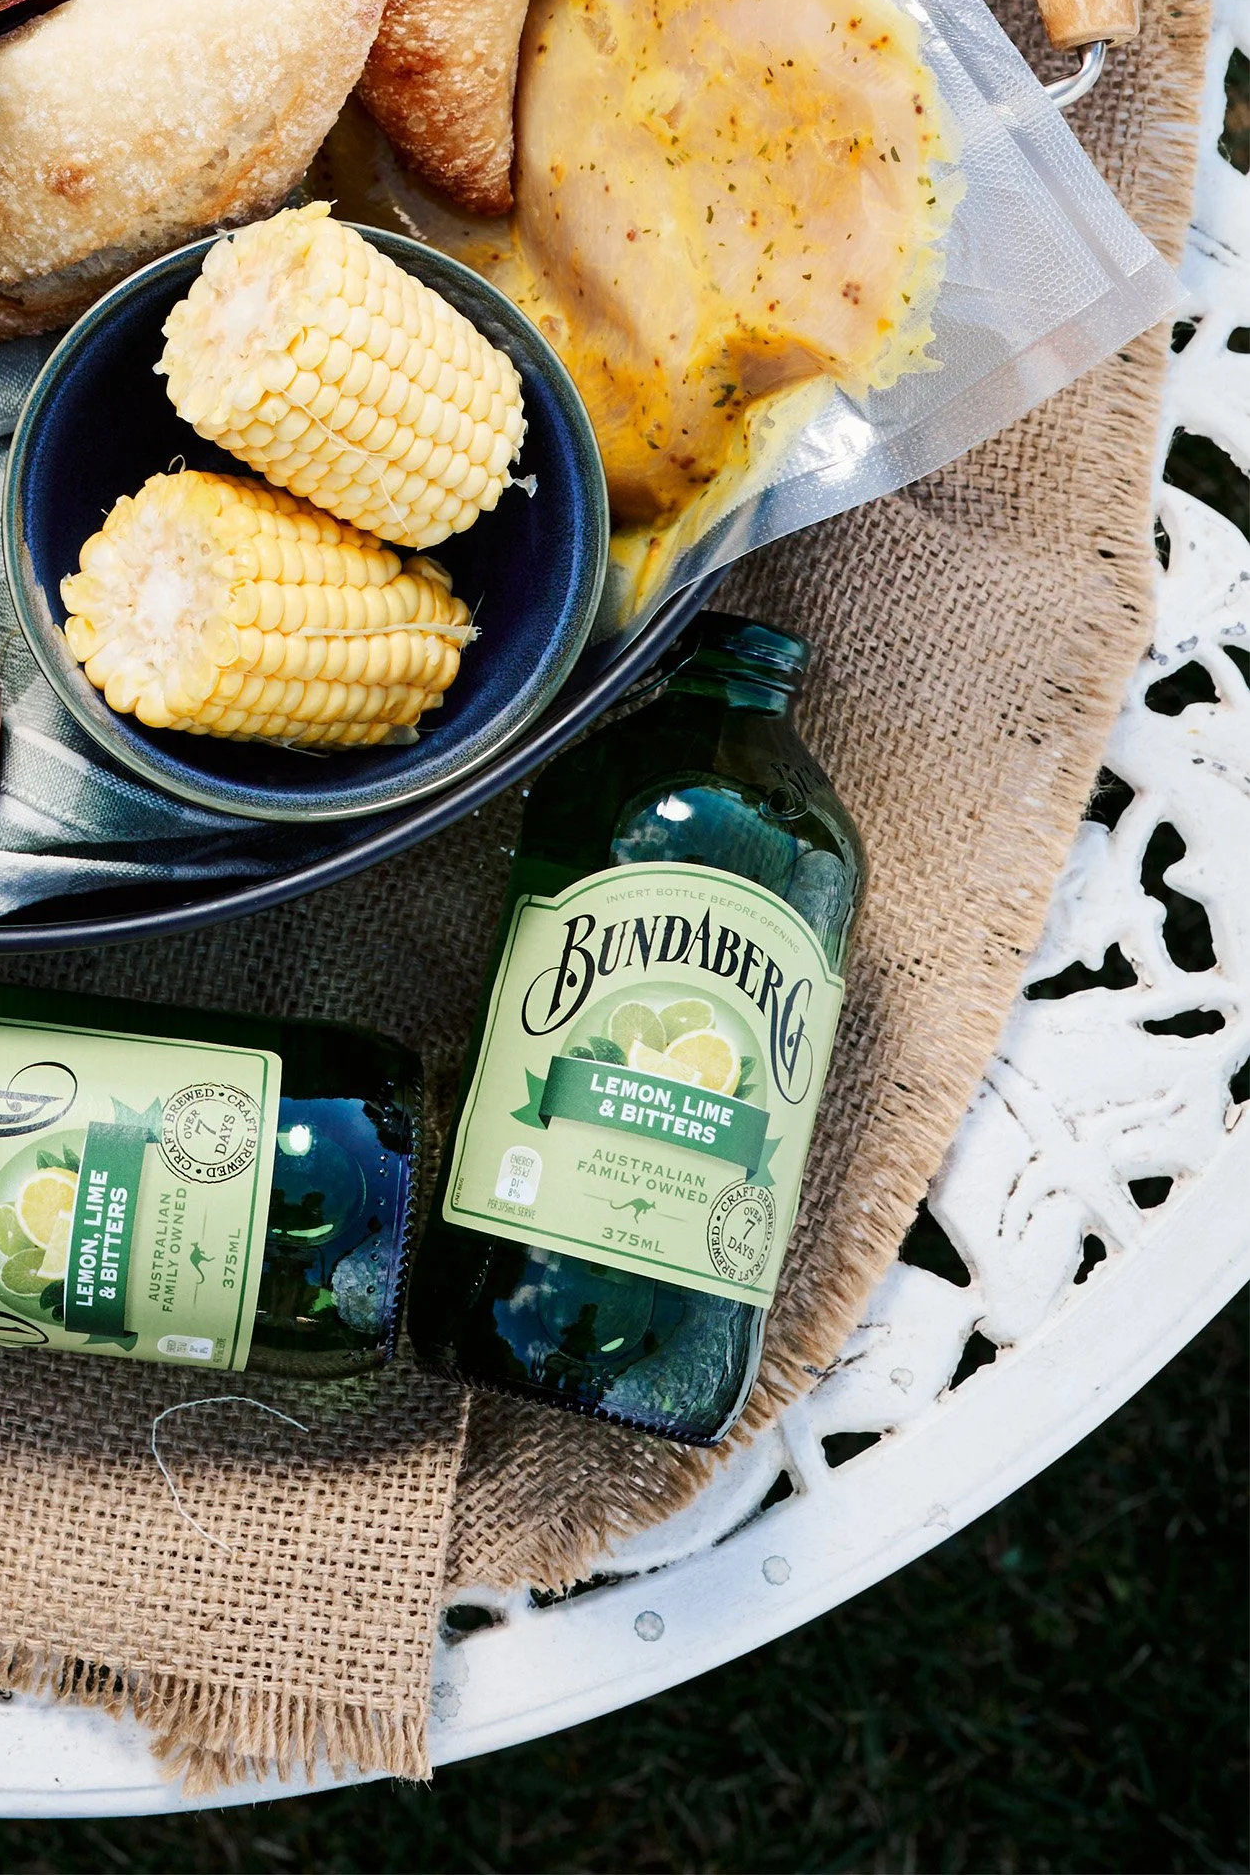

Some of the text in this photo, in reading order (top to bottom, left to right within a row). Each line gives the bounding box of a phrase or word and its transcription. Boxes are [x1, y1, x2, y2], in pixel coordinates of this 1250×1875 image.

[606, 888, 800, 954] INVERT BOTTLE BEFORE OPENING
[521, 906, 813, 1105] BUNDABERG
[590, 1073, 734, 1127] LEMON, LIME
[164, 1089, 257, 1177] CRAFT BREWED CRAFT BREWED
[184, 1109, 200, 1139] OVER
[195, 1119, 216, 1135] 7
[214, 1115, 235, 1156] DAYS
[598, 1099, 717, 1144] & BITTERS
[510, 1154, 535, 1167] ENERGY
[592, 1149, 706, 1187] AUSTRALIAN
[508, 1188, 520, 1198] 8%
[577, 1161, 708, 1204] FAMILY OWNED
[721, 1187, 755, 1212] CRAFT
[744, 1207, 762, 1224] OVER
[744, 1218, 755, 1239] 7
[76, 1170, 108, 1307] LEMON, LIME
[99, 1187, 128, 1299] & BITTERS
[148, 1193, 171, 1301] AUSTRALIAN
[162, 1188, 187, 1312] FAMILY OWNED
[712, 1226, 735, 1279] BREWED
[727, 1237, 754, 1260] DAYS
[738, 1254, 765, 1281] CRAFT
